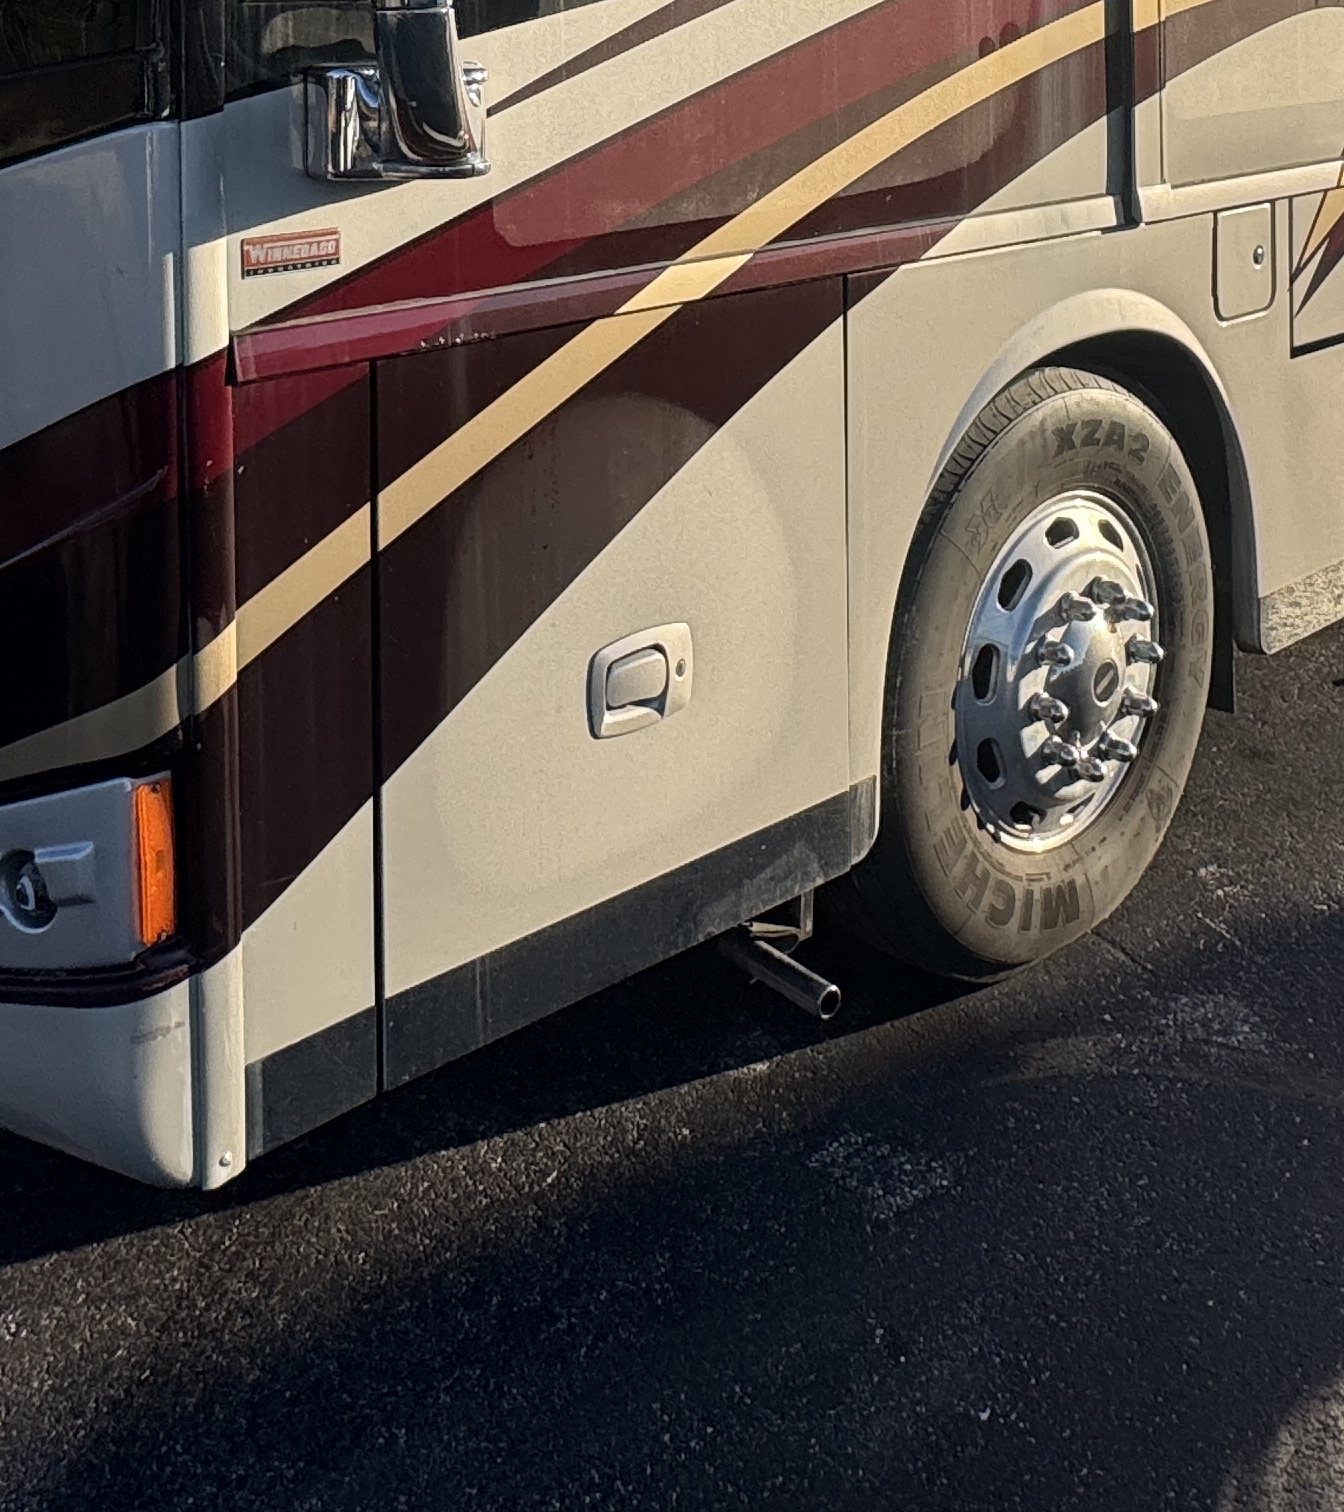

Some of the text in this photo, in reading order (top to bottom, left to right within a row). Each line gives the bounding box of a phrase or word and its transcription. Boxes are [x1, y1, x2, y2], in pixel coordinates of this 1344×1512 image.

[243, 240, 337, 264] WINNEBAGO
[1051, 418, 1151, 465] XZA2
[1157, 460, 1210, 689] ENERGY
